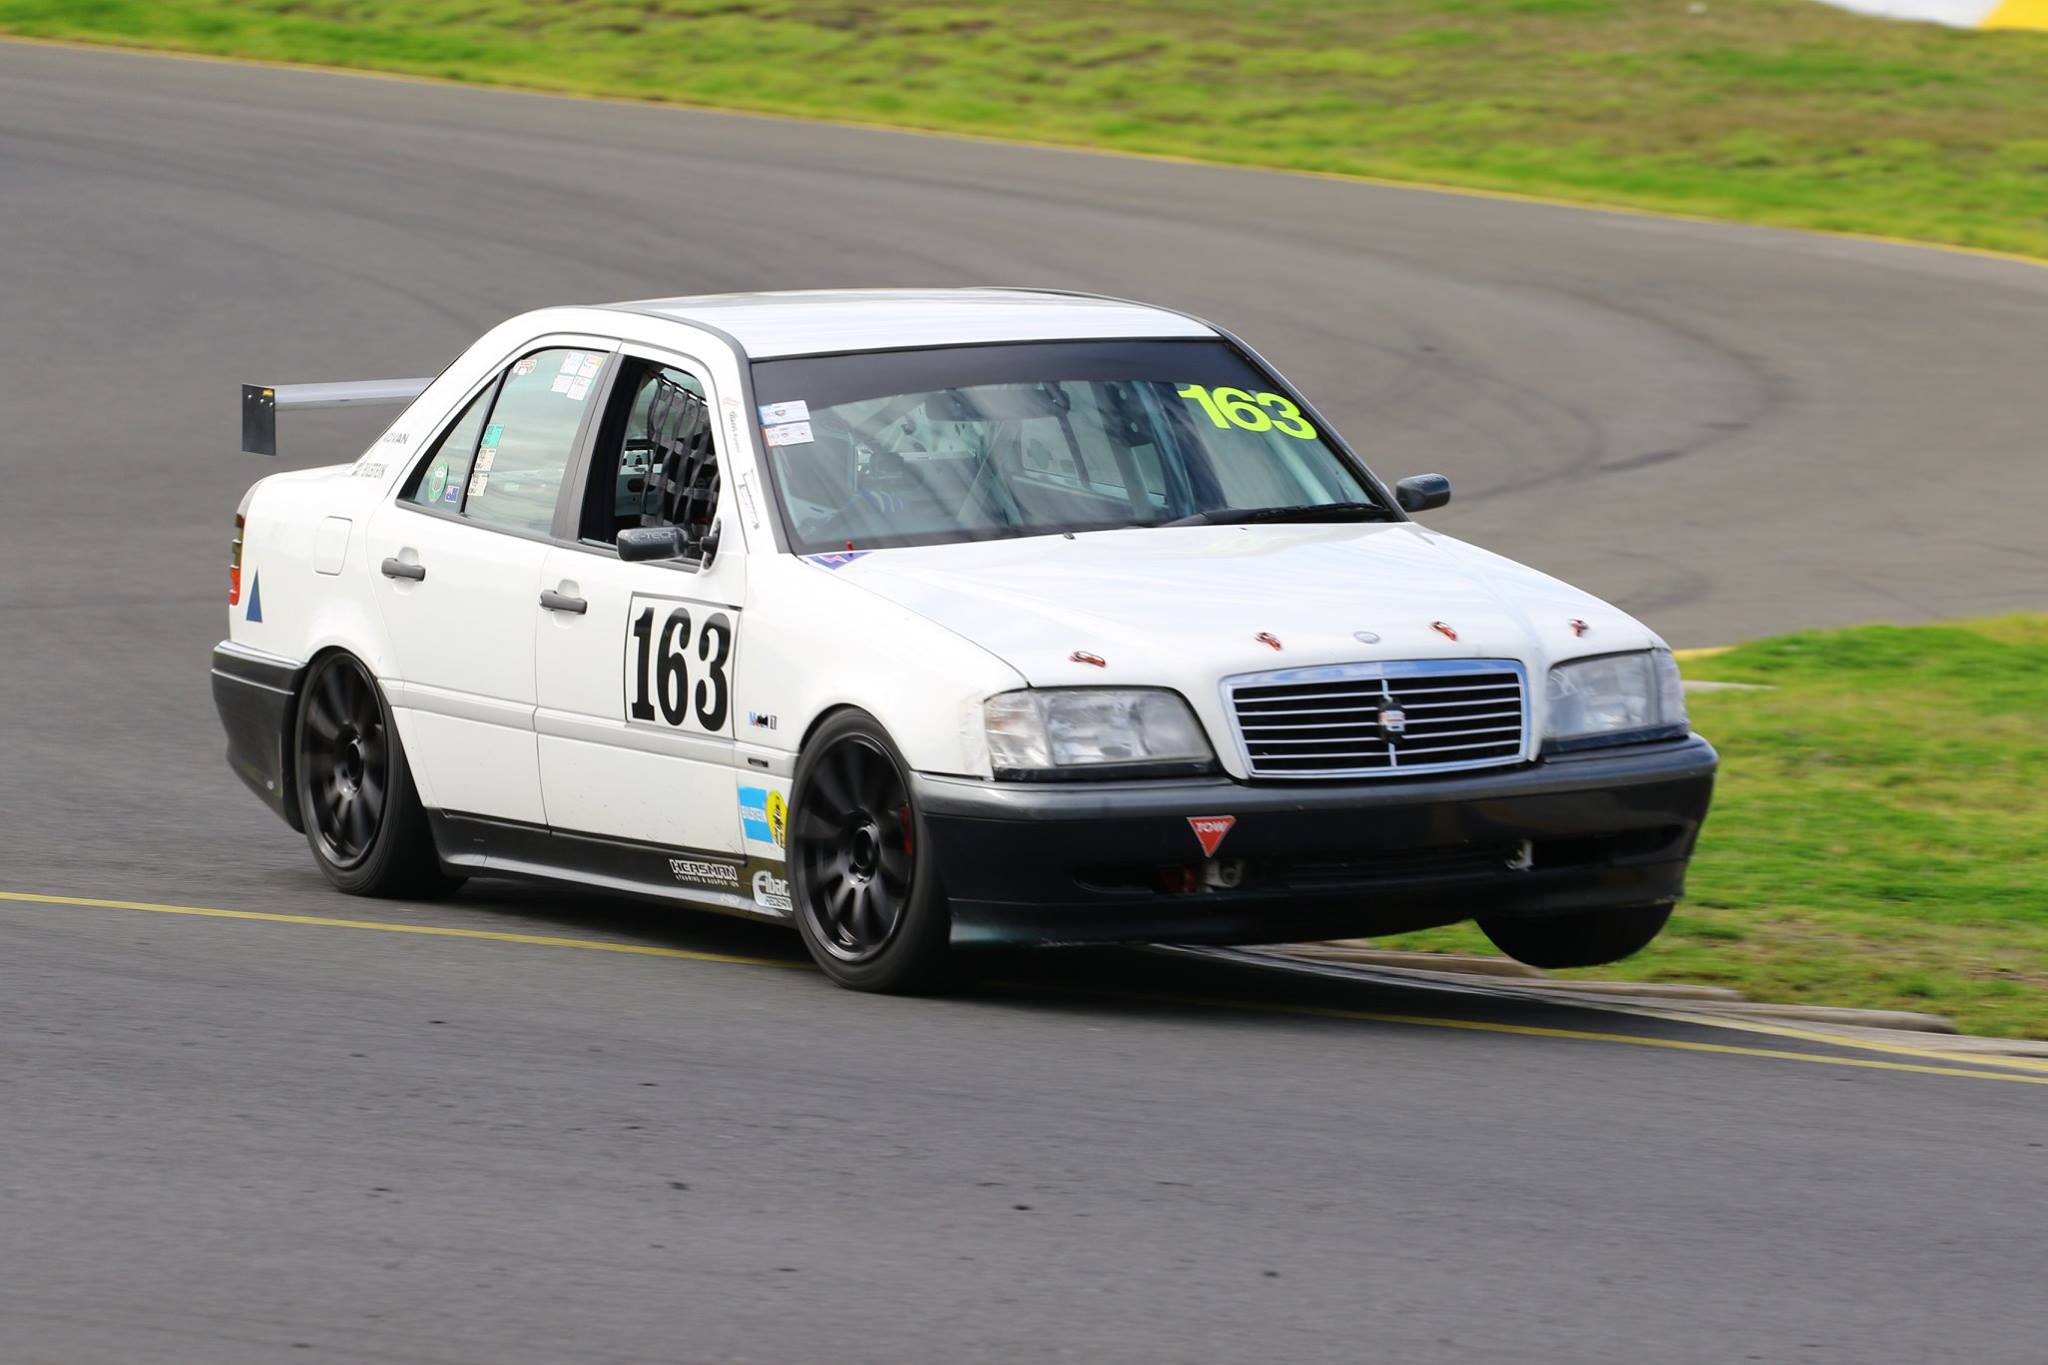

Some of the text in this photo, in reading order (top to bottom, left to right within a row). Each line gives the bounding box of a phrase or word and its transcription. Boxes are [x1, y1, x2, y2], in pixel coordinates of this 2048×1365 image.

[1177, 384, 1318, 440] 163
[631, 606, 731, 732] 163
[1195, 821, 1231, 832] TOW
[752, 870, 791, 906] Eibac
